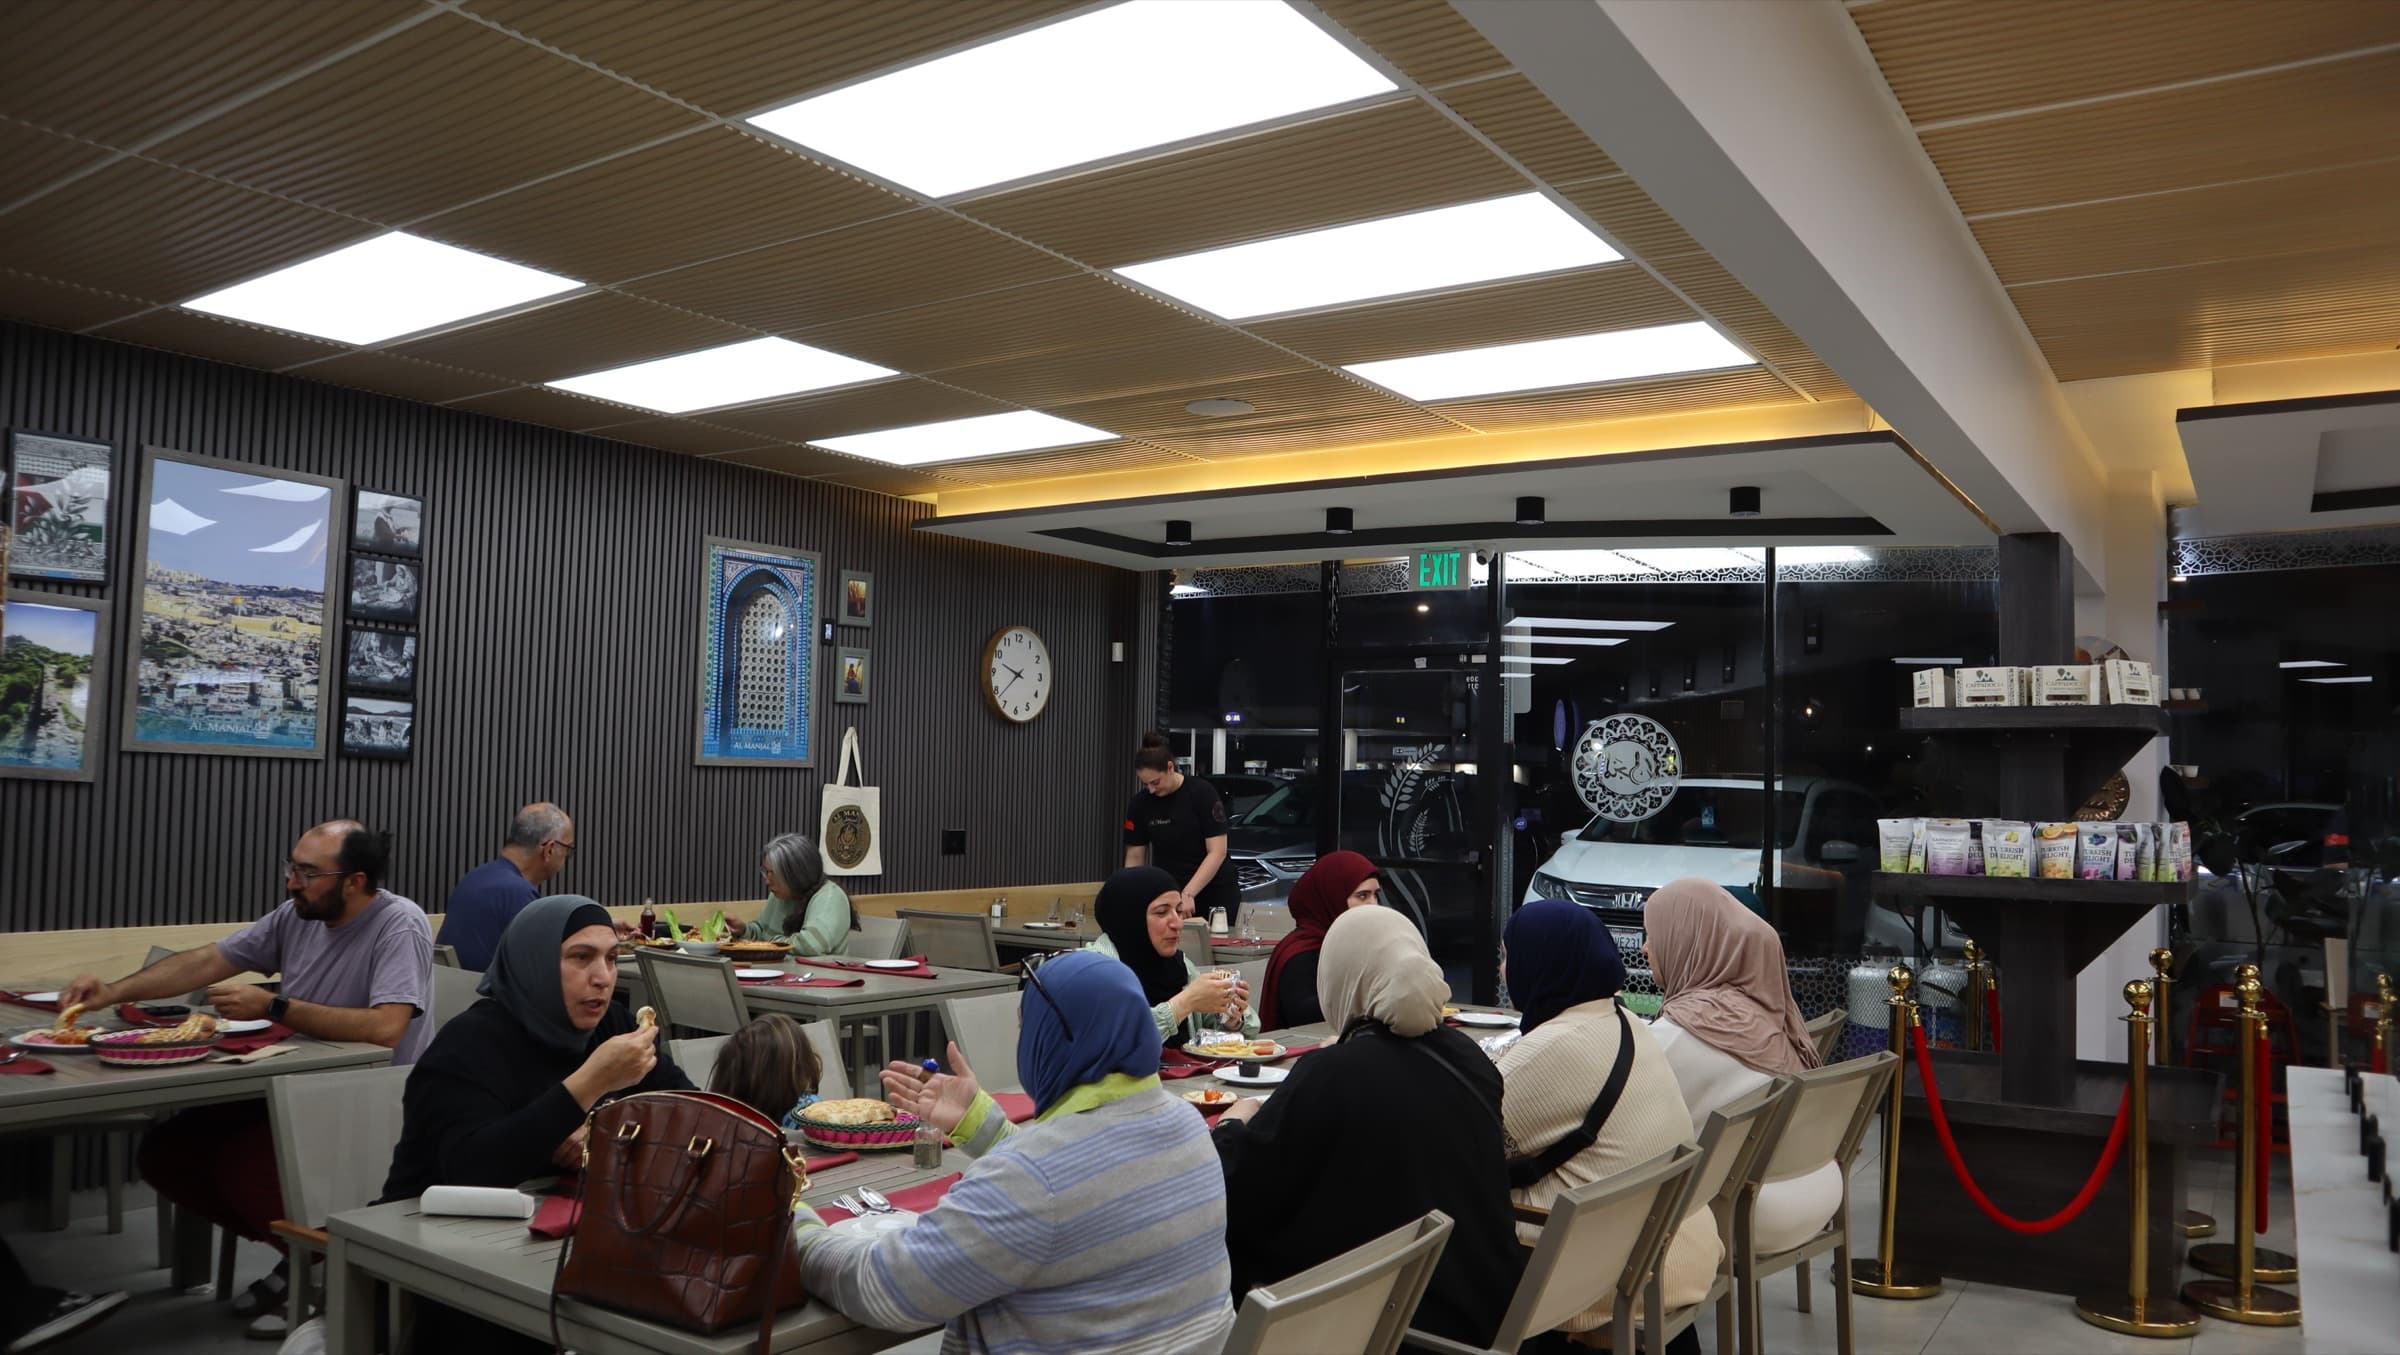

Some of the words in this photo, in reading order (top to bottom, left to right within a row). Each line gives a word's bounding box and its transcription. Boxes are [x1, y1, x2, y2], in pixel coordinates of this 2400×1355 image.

[1419, 553, 1461, 587] EXIT
[1003, 636, 1011, 647] 11
[1015, 633, 1024, 643] 12
[1028, 640, 1032, 650] 1
[994, 649, 1003, 659] 10
[1034, 655, 1040, 664] 2
[991, 667, 997, 677] 9
[1037, 672, 1043, 682] 3
[993, 685, 999, 695] 8
[1033, 689, 1039, 699] 4
[1002, 700, 1007, 709] 7
[1024, 702, 1030, 711] 5
[1013, 706, 1018, 715] 6
